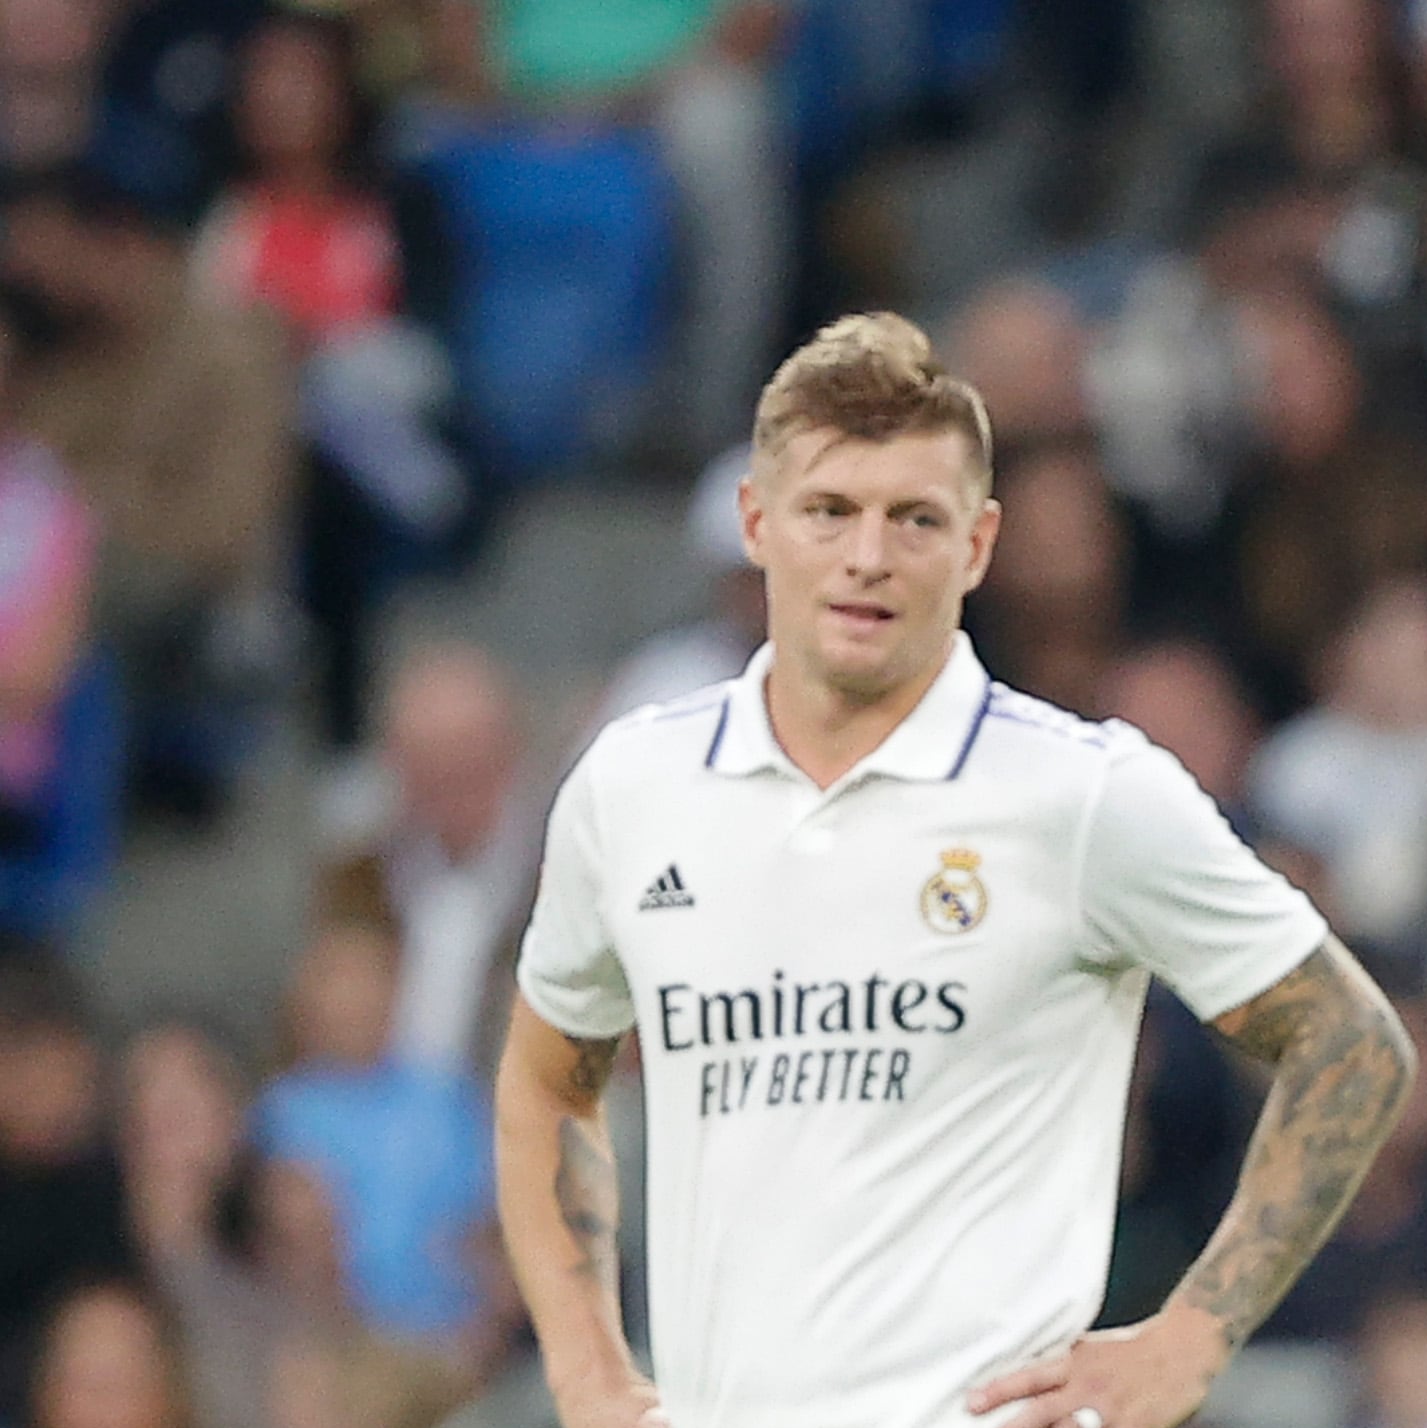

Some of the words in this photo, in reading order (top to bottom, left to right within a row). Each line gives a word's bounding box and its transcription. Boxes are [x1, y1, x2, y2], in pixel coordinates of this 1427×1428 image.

[657, 970, 968, 1053] Emirates
[700, 1056, 757, 1118] FLY
[766, 1048, 911, 1105] BETTER
